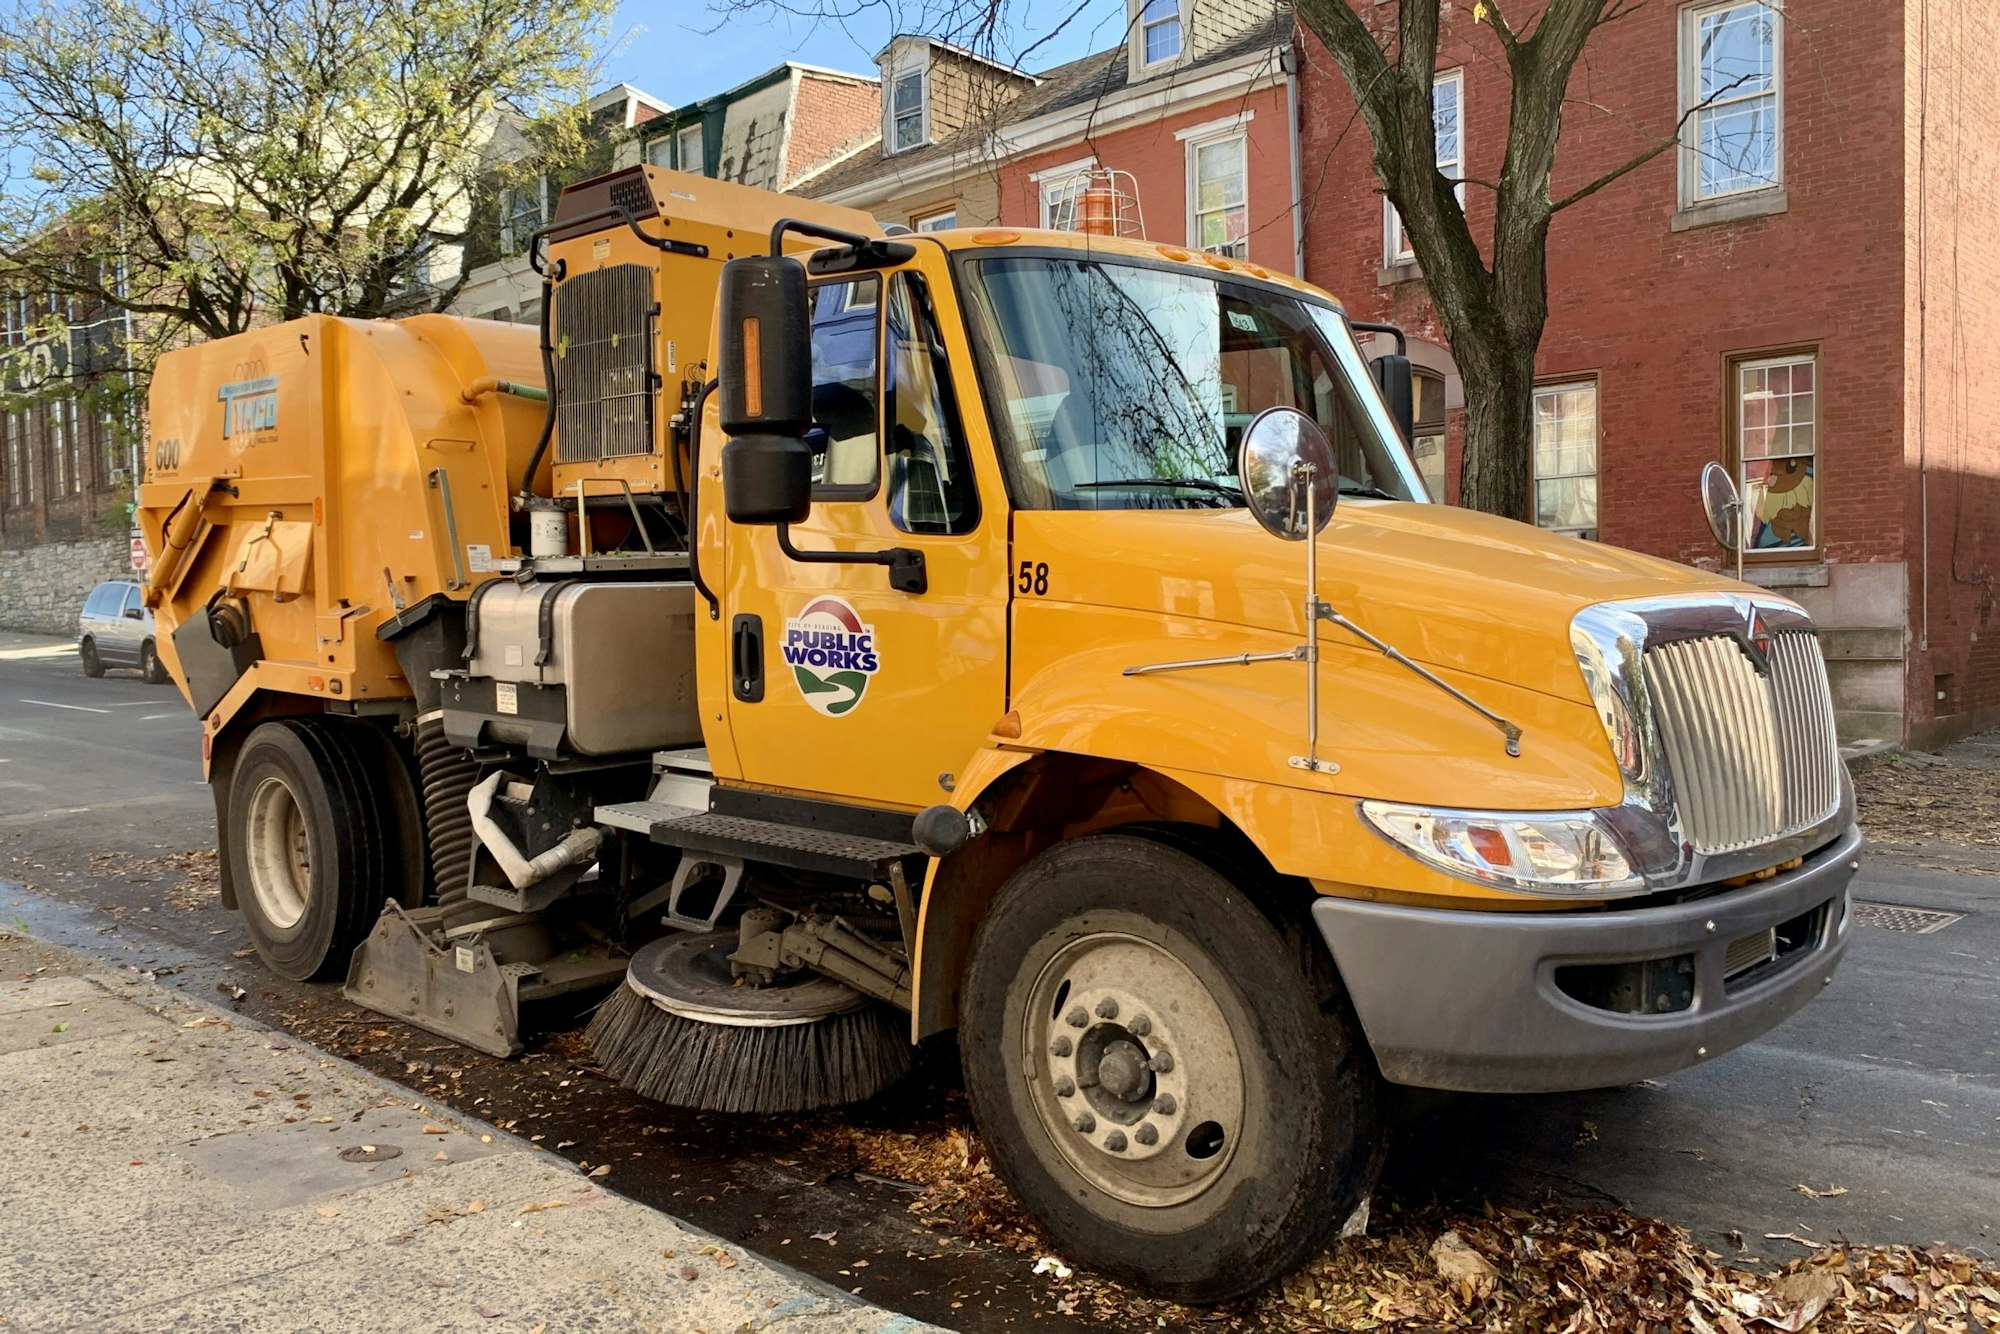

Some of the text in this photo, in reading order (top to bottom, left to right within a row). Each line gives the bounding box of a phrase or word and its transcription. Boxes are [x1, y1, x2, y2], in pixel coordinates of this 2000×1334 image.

[156, 439, 180, 470] 600
[1018, 561, 1049, 596] 58
[788, 630, 872, 653] PUBLIC
[783, 647, 878, 672] WORKS
